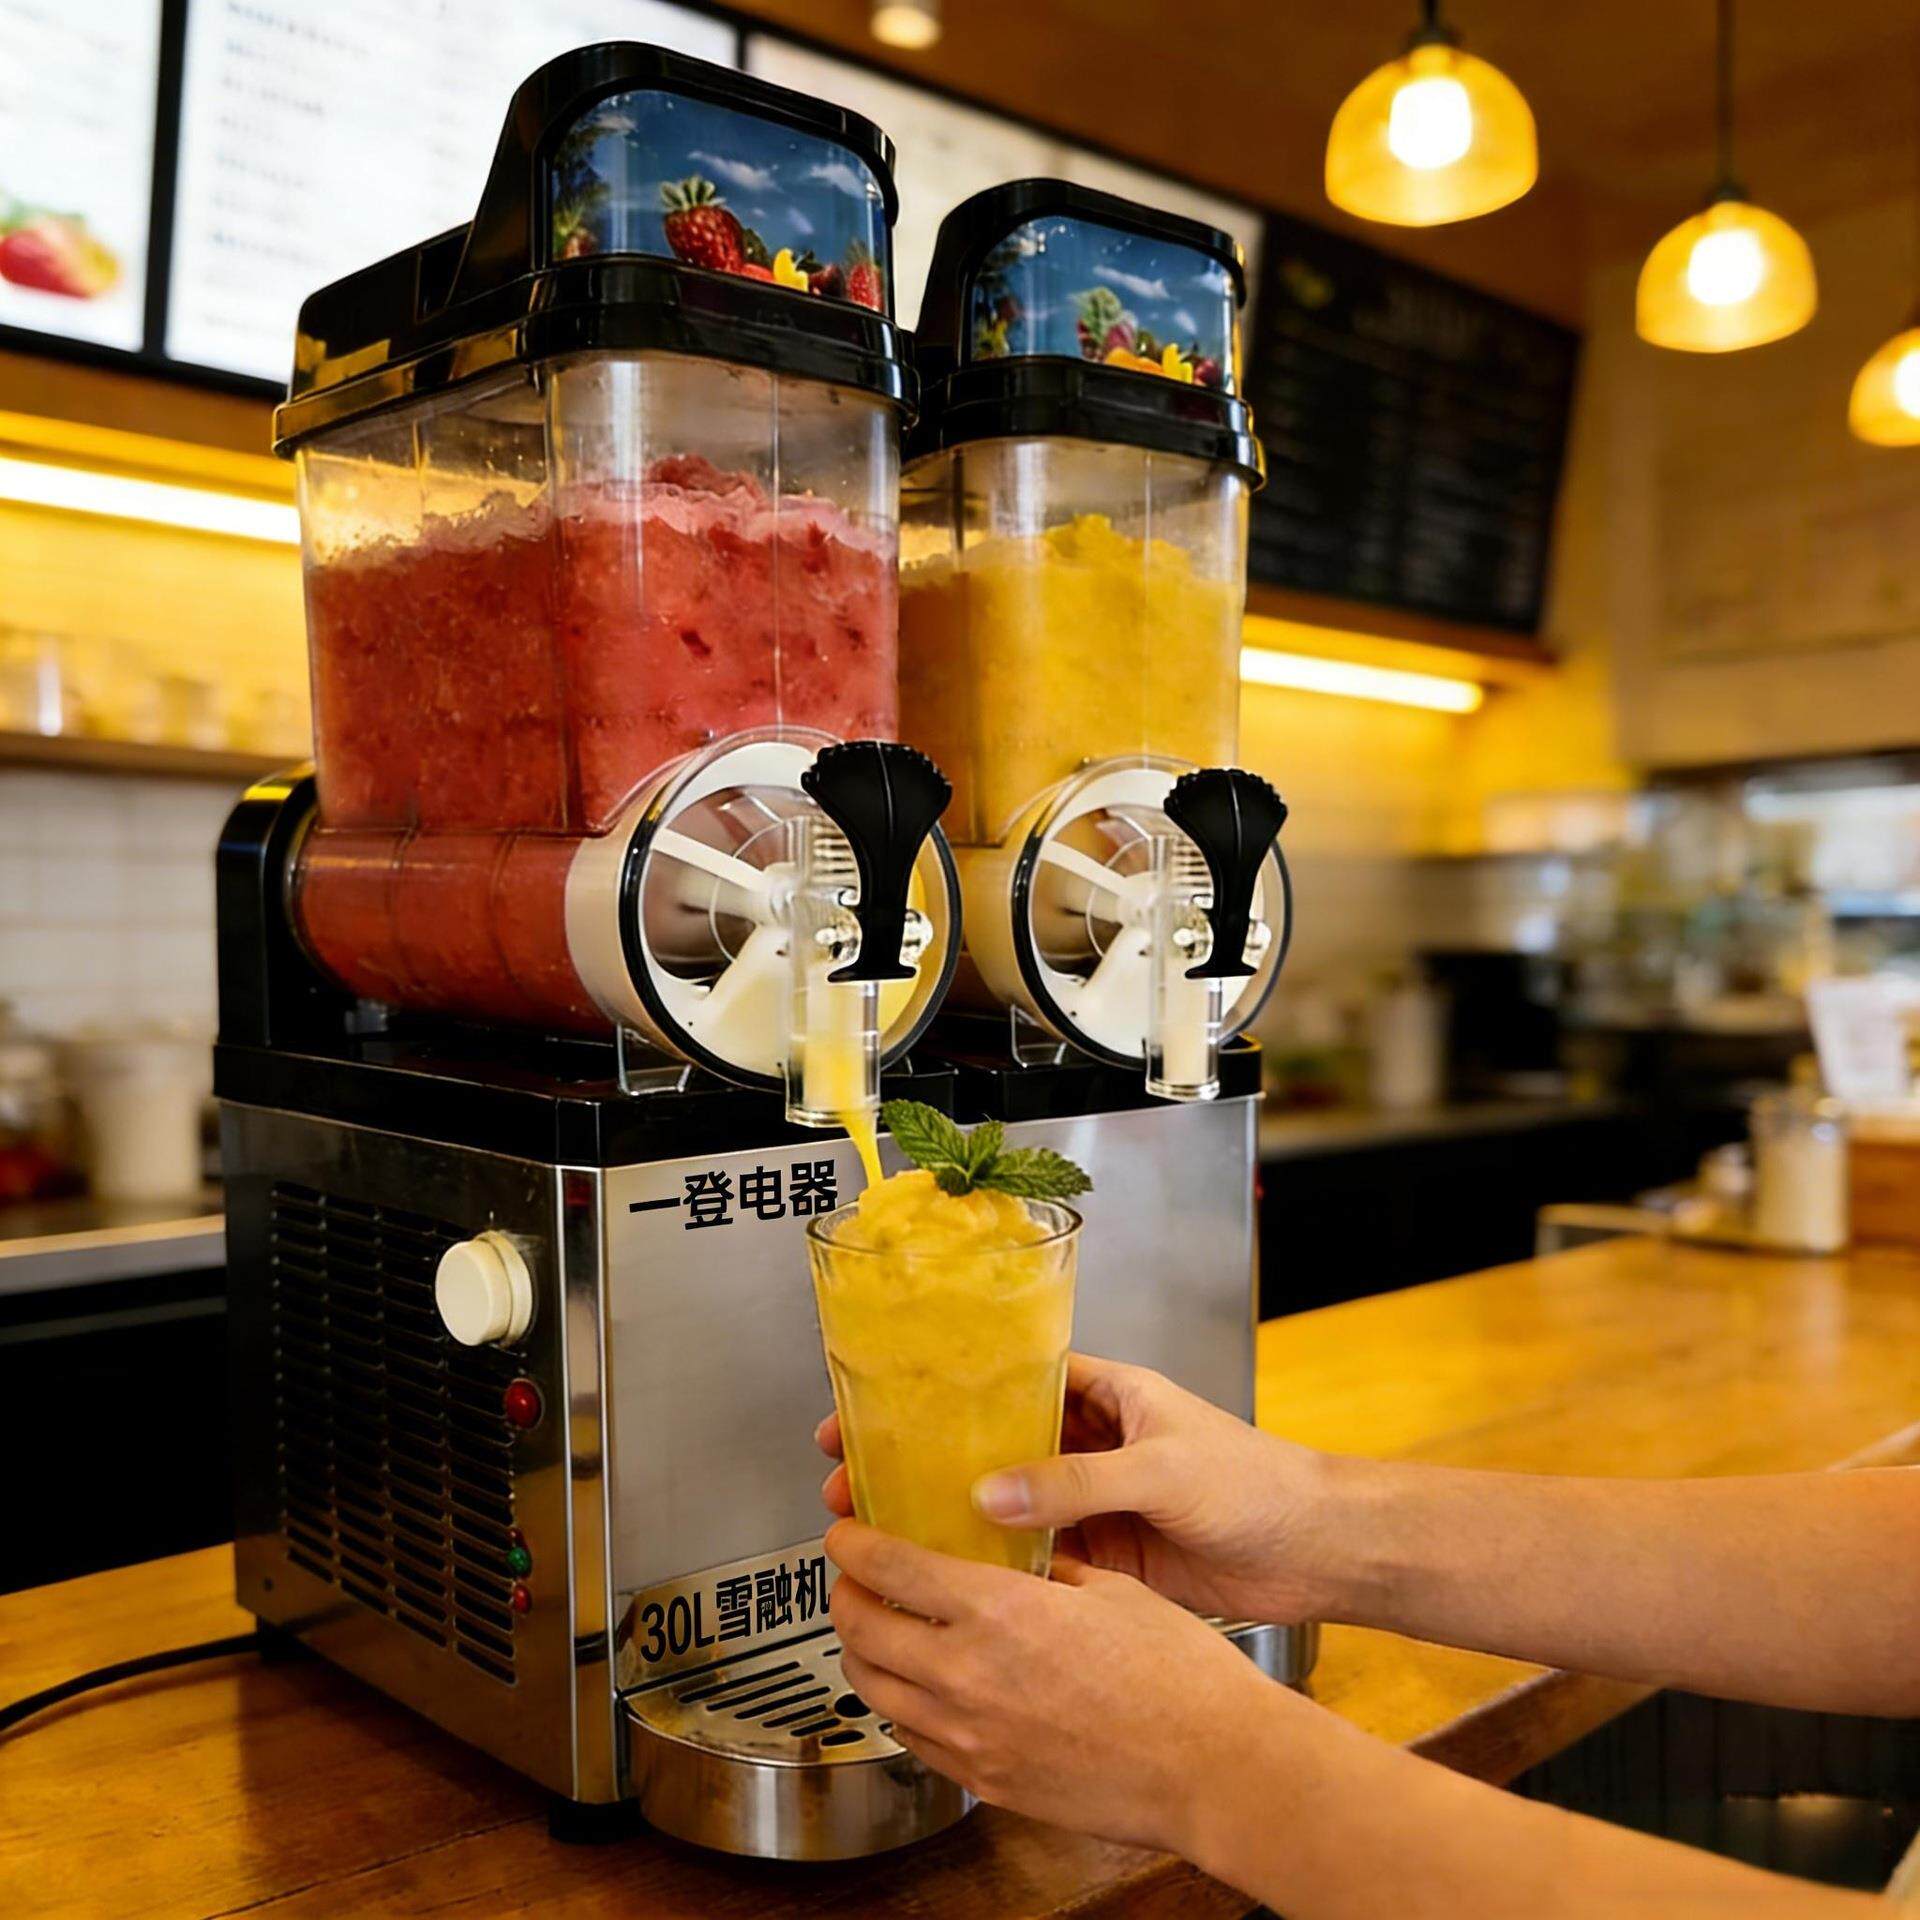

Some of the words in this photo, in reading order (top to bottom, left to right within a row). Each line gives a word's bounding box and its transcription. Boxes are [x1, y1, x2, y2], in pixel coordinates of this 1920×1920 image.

[629, 1159, 838, 1230] 一登电器
[640, 1556, 831, 1662] 30L雪融机
